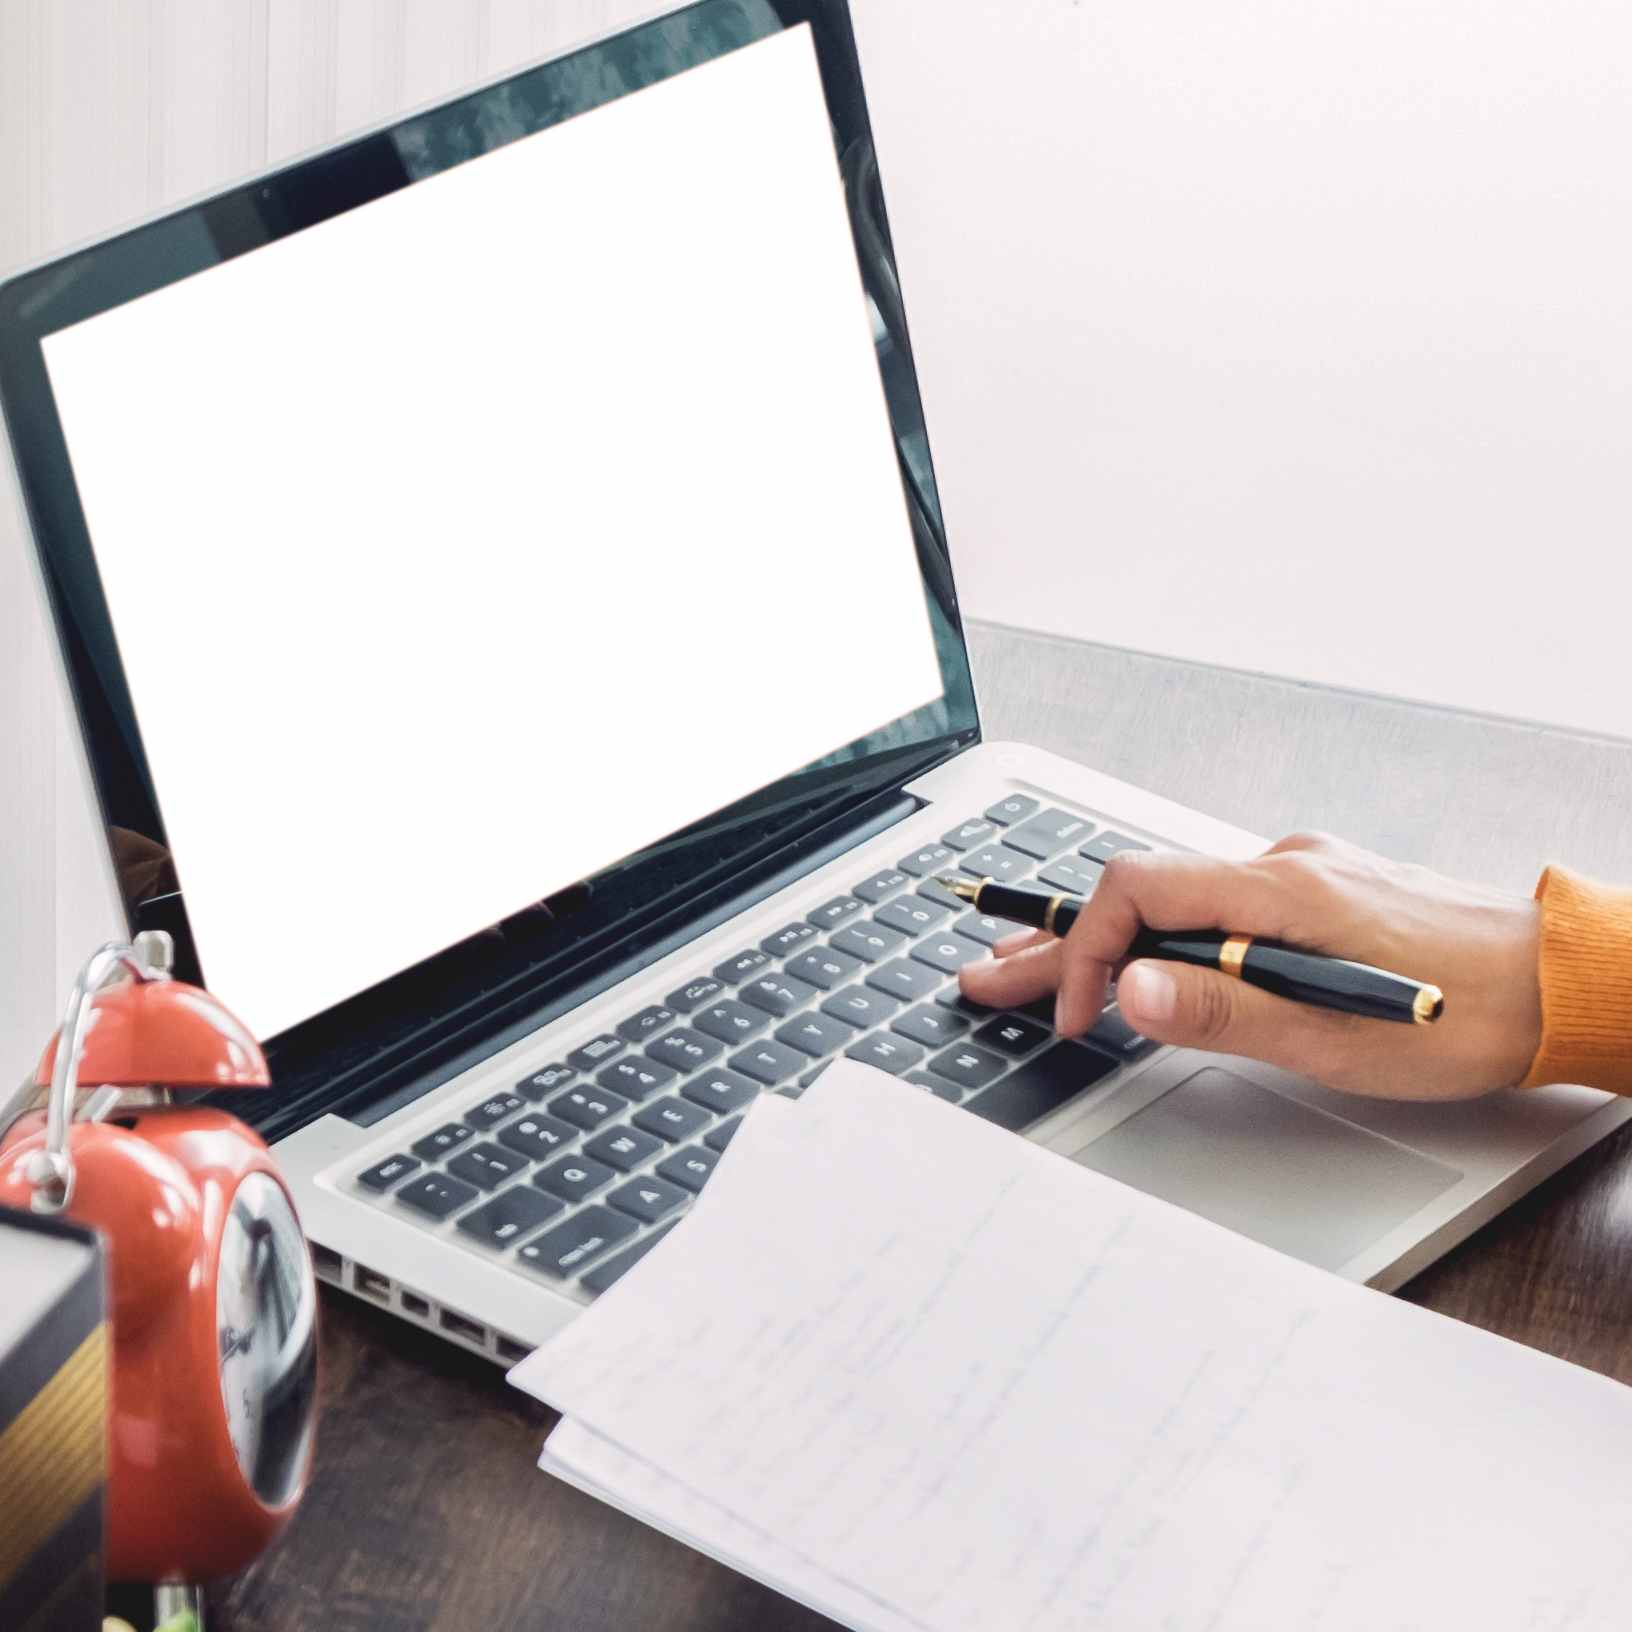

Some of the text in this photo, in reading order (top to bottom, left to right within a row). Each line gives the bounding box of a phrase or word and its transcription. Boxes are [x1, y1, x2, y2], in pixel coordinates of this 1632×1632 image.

[867, 937, 885, 947] 9
[938, 944, 958, 955] O
[777, 988, 795, 1000] 7
[848, 997, 869, 1009] U
[733, 1017, 751, 1028] 6
[922, 1016, 939, 1028] J
[803, 1024, 823, 1036] Y
[1000, 1027, 1025, 1041] M
[685, 1043, 704, 1056] 5
[873, 1042, 896, 1056] H
[756, 1053, 777, 1063] T
[955, 1054, 980, 1069] N
[637, 1072, 656, 1084] 4
[710, 1081, 731, 1093] R
[588, 1101, 608, 1114] 3
[661, 1110, 684, 1122] E
[538, 1130, 560, 1144] 2
[609, 1137, 636, 1153] W
[489, 1160, 509, 1171] 1
[686, 1160, 707, 1173] S
[563, 1168, 588, 1182] Q
[639, 1189, 661, 1203] A
